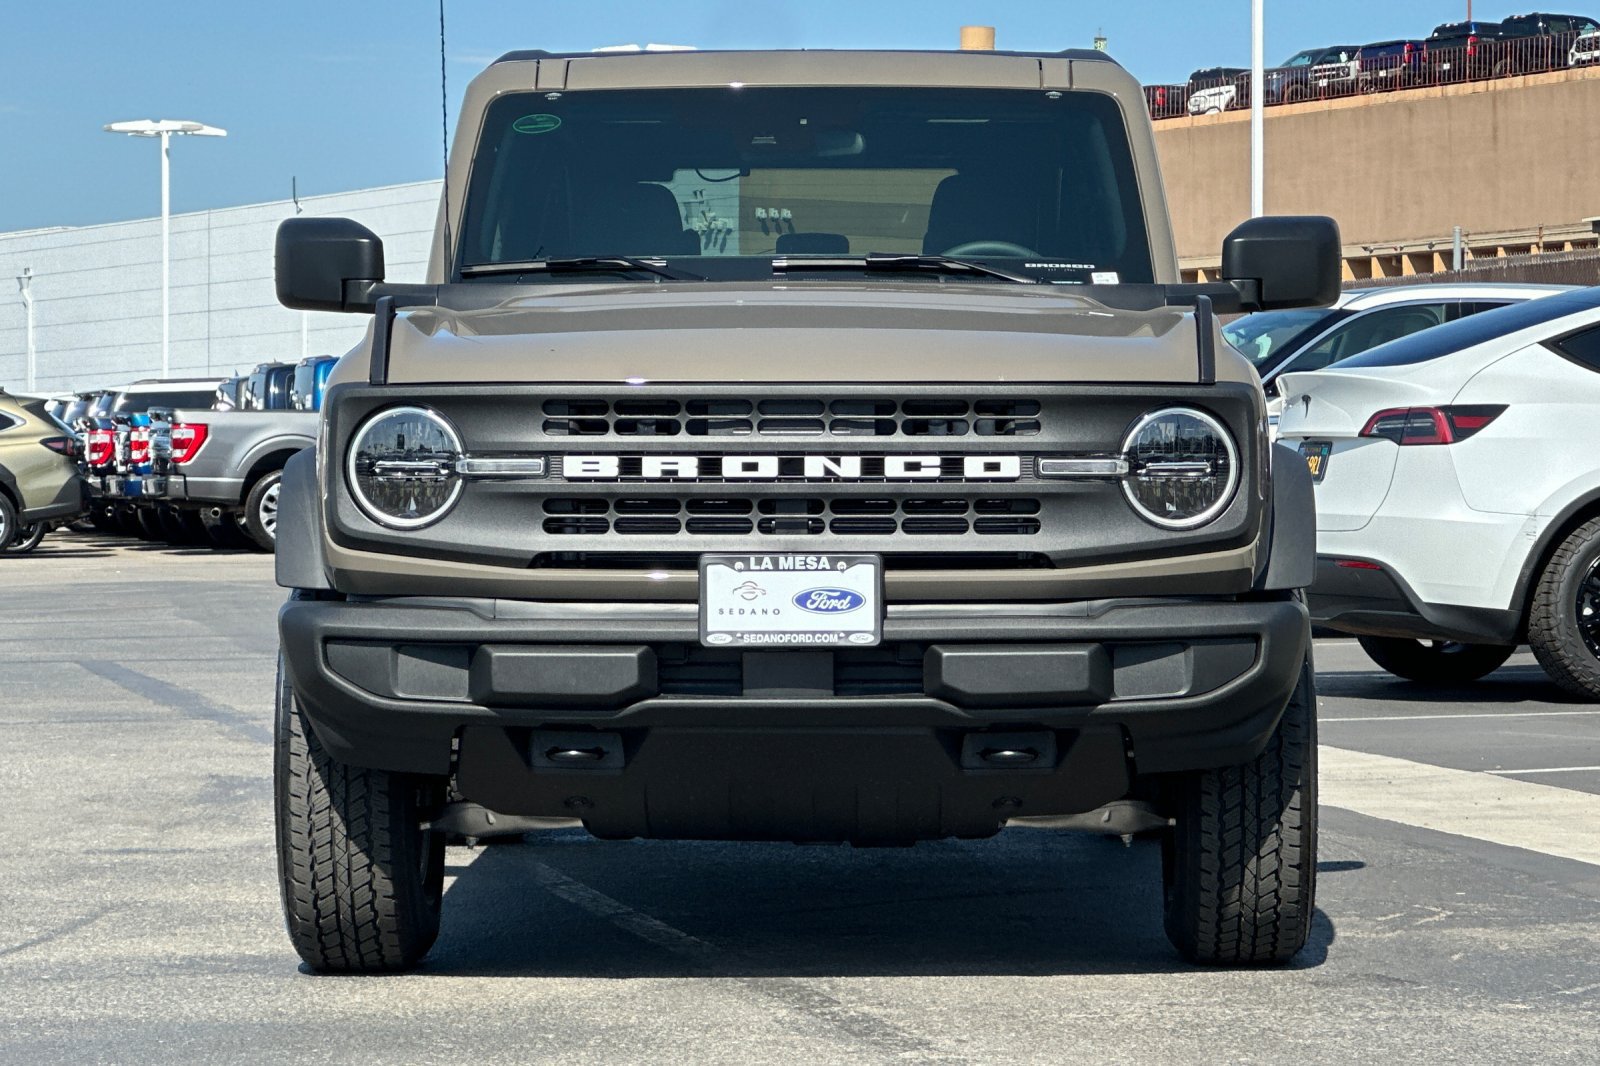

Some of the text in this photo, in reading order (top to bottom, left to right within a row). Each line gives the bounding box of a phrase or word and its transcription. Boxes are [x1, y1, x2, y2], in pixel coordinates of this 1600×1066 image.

[563, 456, 1021, 478] BRONCO
[750, 556, 831, 570] LA MESA
[806, 590, 852, 610] Ford
[743, 633, 838, 643] SEDANOFORD.COM
